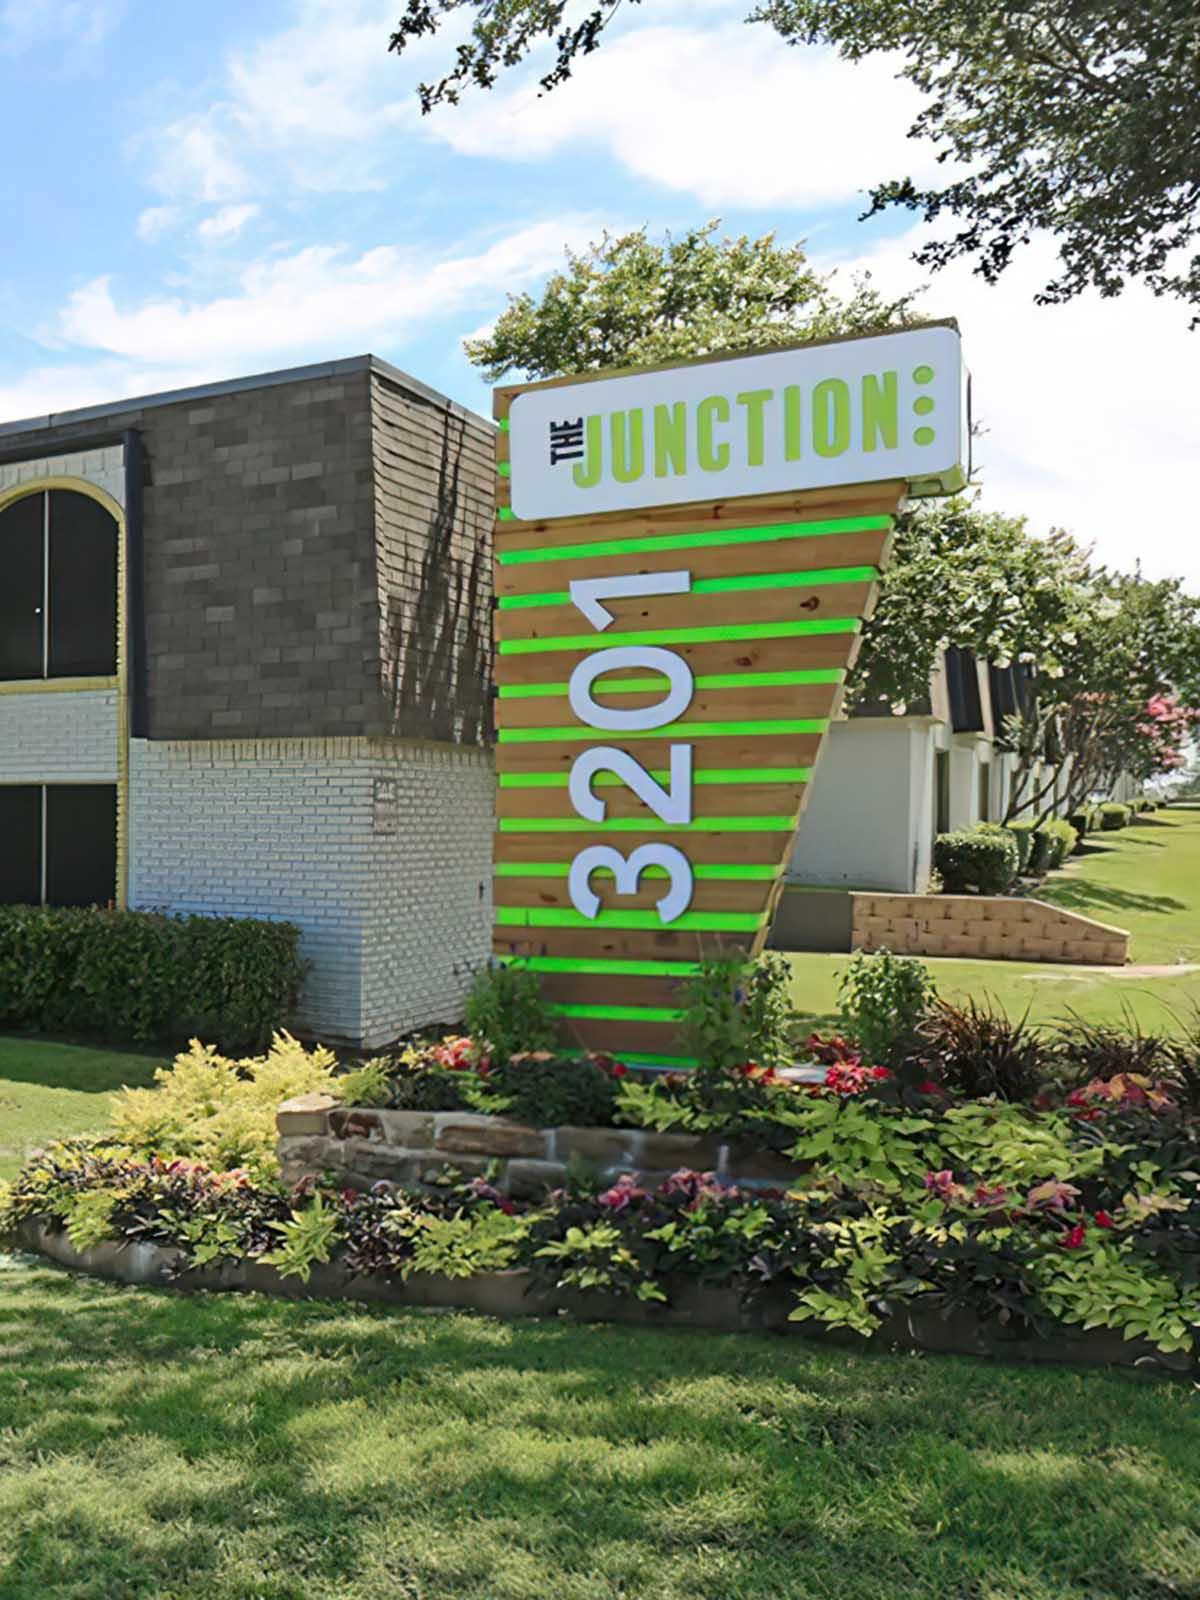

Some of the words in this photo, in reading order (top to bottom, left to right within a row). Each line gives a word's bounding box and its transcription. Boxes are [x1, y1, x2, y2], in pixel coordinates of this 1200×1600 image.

[550, 416, 584, 466] THE
[572, 371, 898, 488] JUNCTION
[569, 570, 693, 923] 3201
